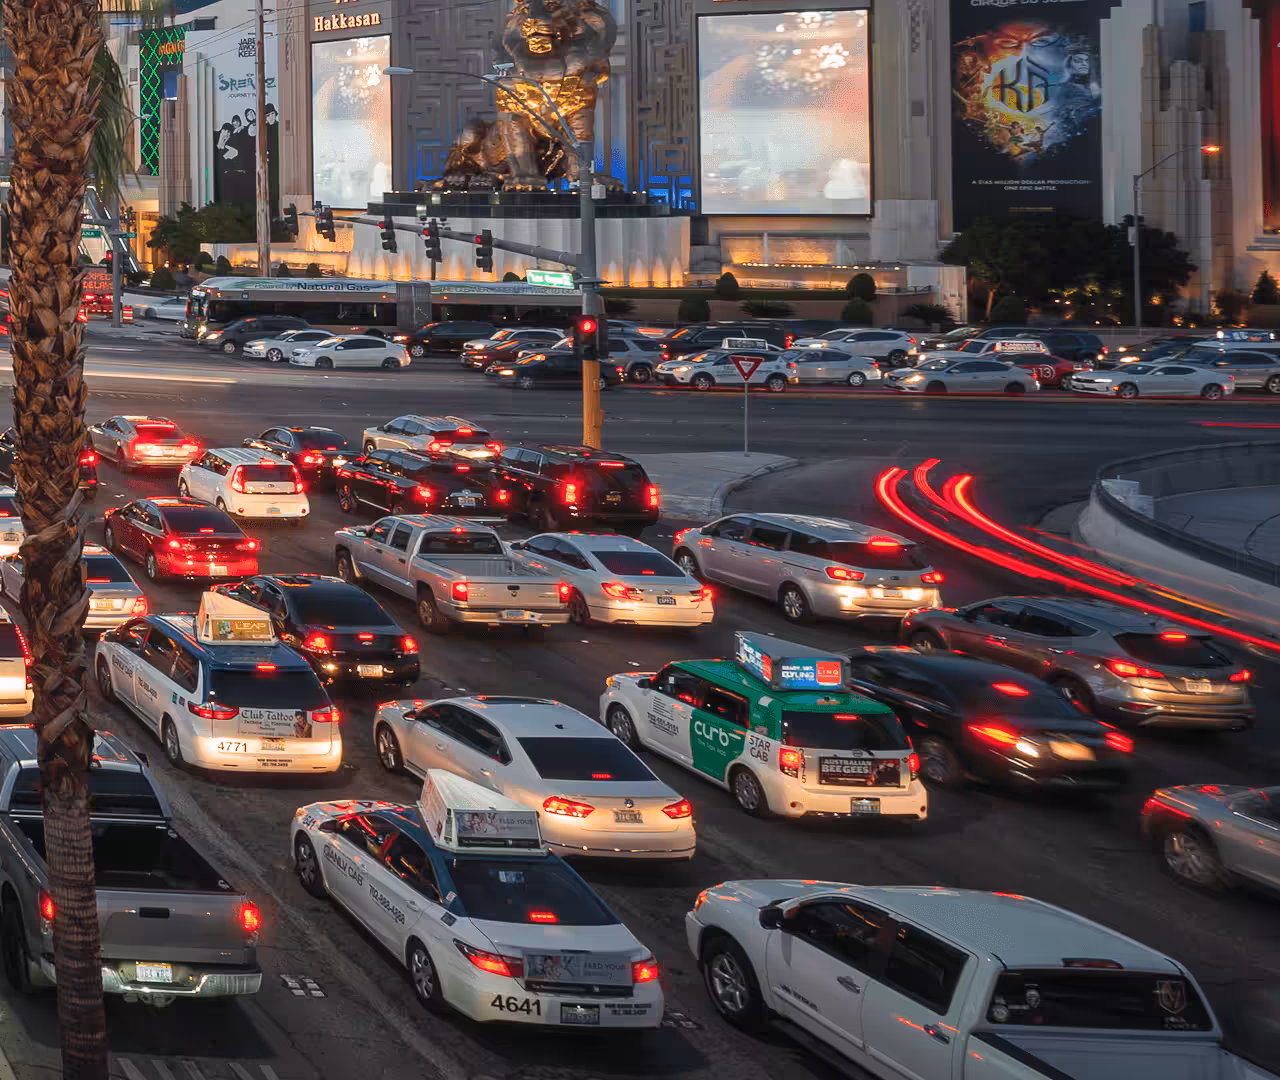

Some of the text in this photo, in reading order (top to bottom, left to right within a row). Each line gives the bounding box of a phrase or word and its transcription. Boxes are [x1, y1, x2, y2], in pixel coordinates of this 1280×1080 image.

[314, 12, 381, 32] Hakkasan
[297, 282, 343, 291] Natural
[346, 283, 371, 291] Gas
[241, 709, 294, 721] Club Tattoo
[694, 720, 729, 746] curb
[217, 741, 248, 753] 4771
[748, 734, 771, 752] STAR
[749, 747, 769, 762] CAB
[823, 758, 872, 767] AUSTRALIAN
[348, 865, 364, 887] CAB
[491, 994, 542, 1017] 4641
